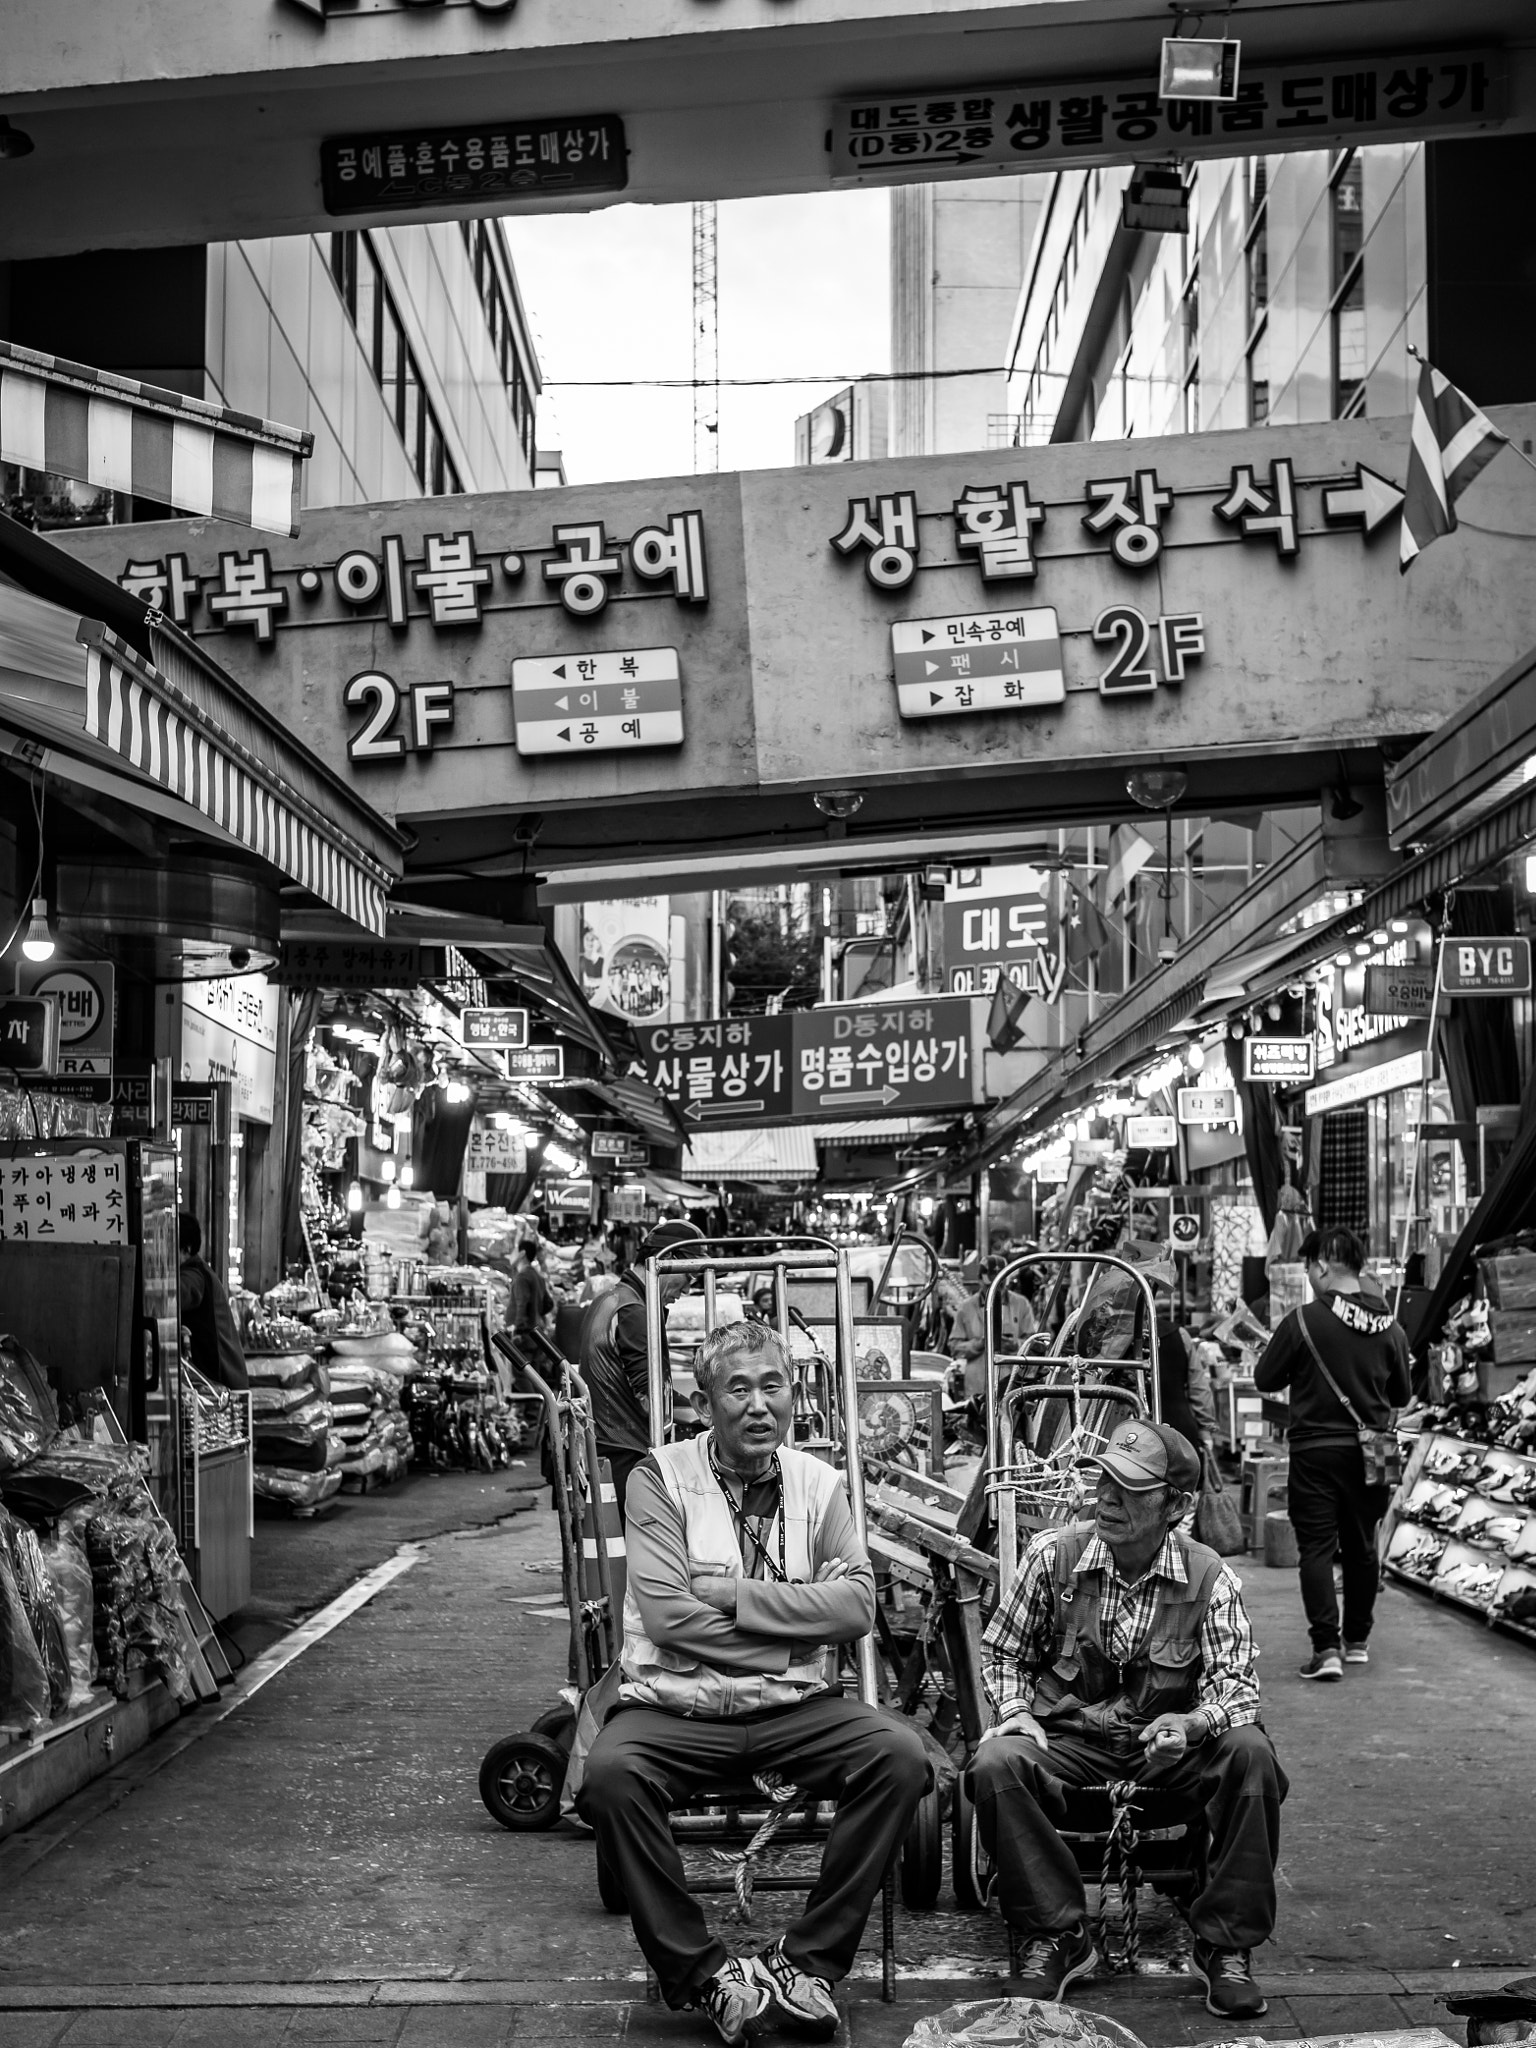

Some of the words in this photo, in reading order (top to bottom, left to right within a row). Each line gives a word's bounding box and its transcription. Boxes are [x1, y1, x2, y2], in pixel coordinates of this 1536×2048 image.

[851, 98, 994, 129] 대도종합
[1004, 61, 1490, 150] 생활공예품도매상가
[848, 127, 993, 157] (D동)2층
[946, 615, 1026, 645] 민속공예
[1093, 604, 1205, 699] 2F
[343, 670, 454, 761] 2F
[963, 904, 1049, 951] 대도
[1458, 947, 1513, 976] BYC
[953, 965, 1035, 993] 아케이
[650, 1022, 752, 1053] C동지하
[834, 1008, 934, 1039] D동지하
[59, 1060, 96, 1073] RA
[800, 1036, 968, 1090] 명품수입상가
[104, 1163, 124, 1245] 미숫가
